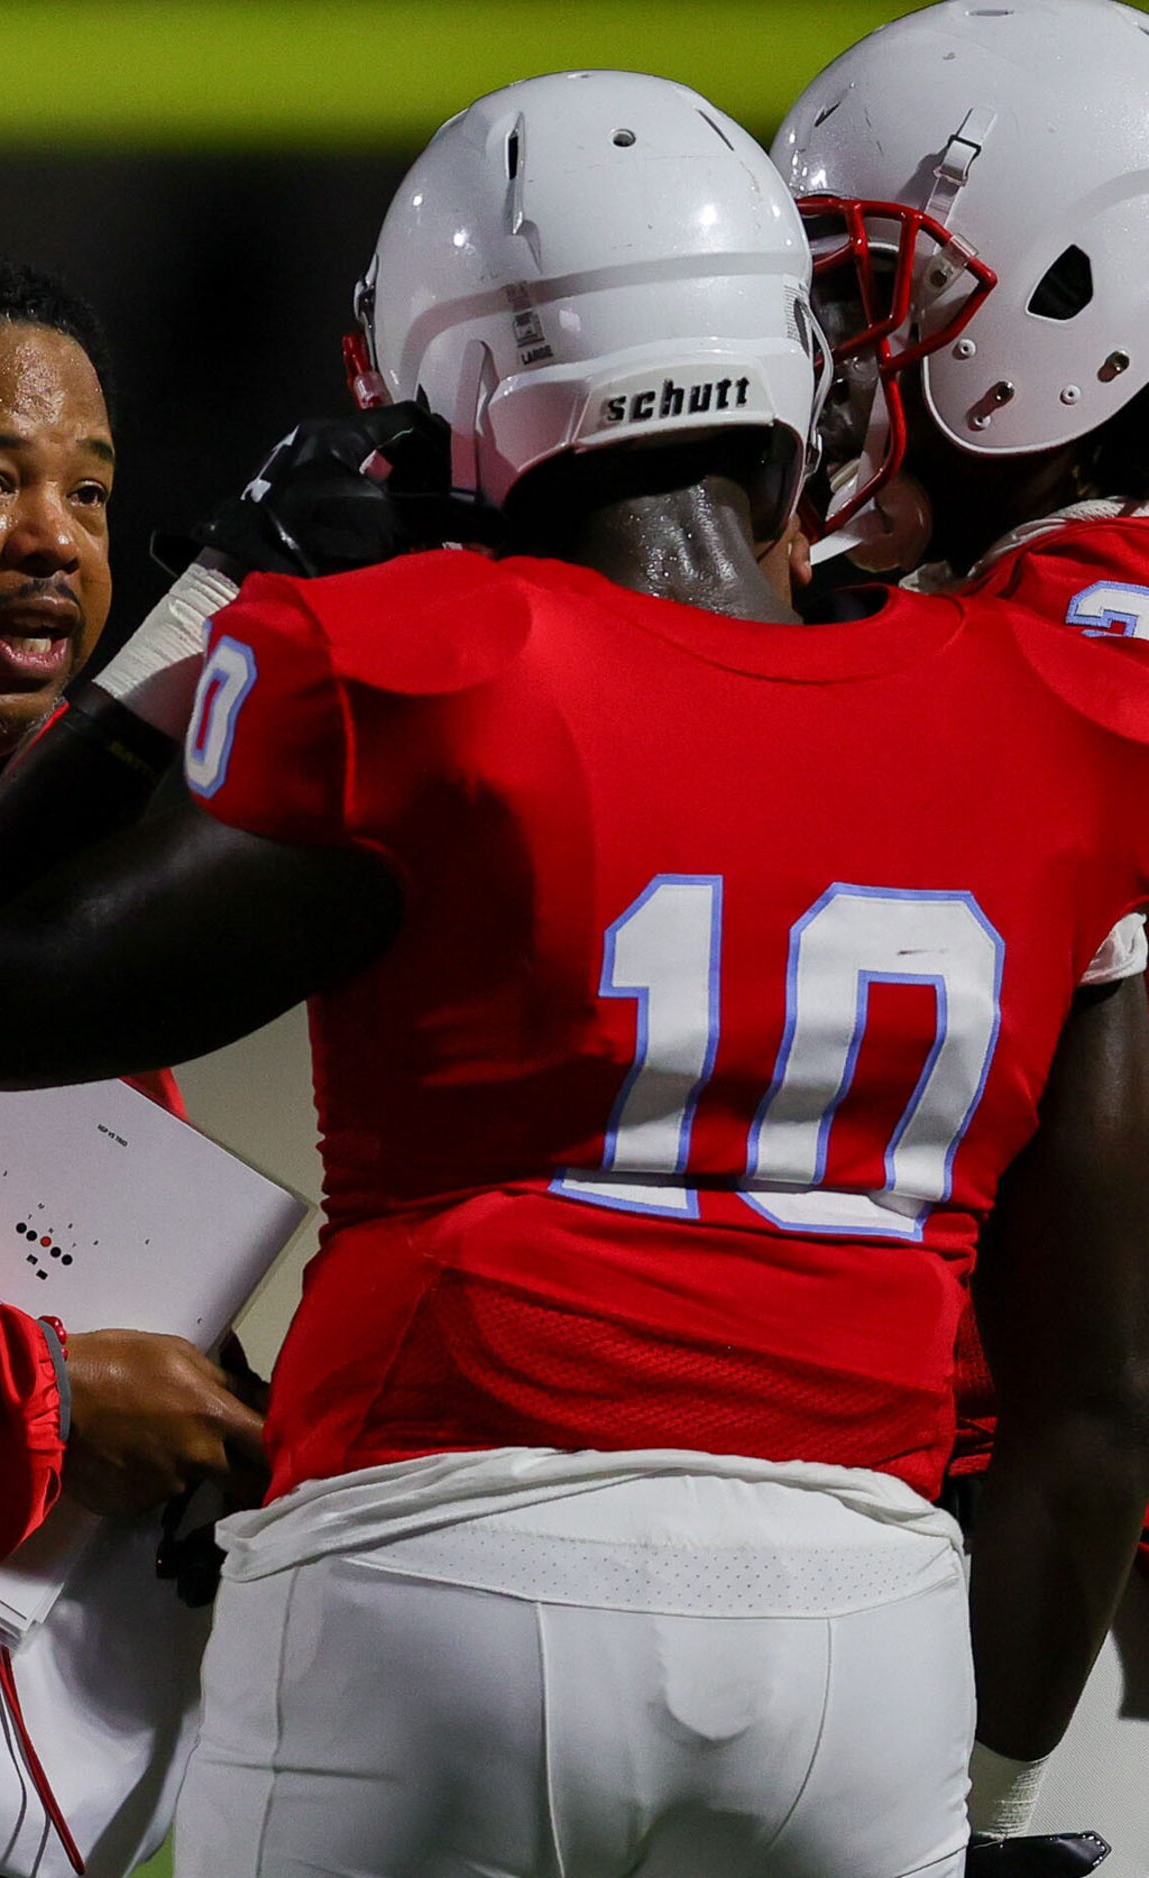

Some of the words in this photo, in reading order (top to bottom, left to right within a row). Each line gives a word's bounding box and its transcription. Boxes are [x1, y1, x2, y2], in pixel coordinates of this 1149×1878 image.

[603, 375, 750, 423] schutt
[184, 617, 259, 799] 0
[547, 873, 1006, 1243] 10
